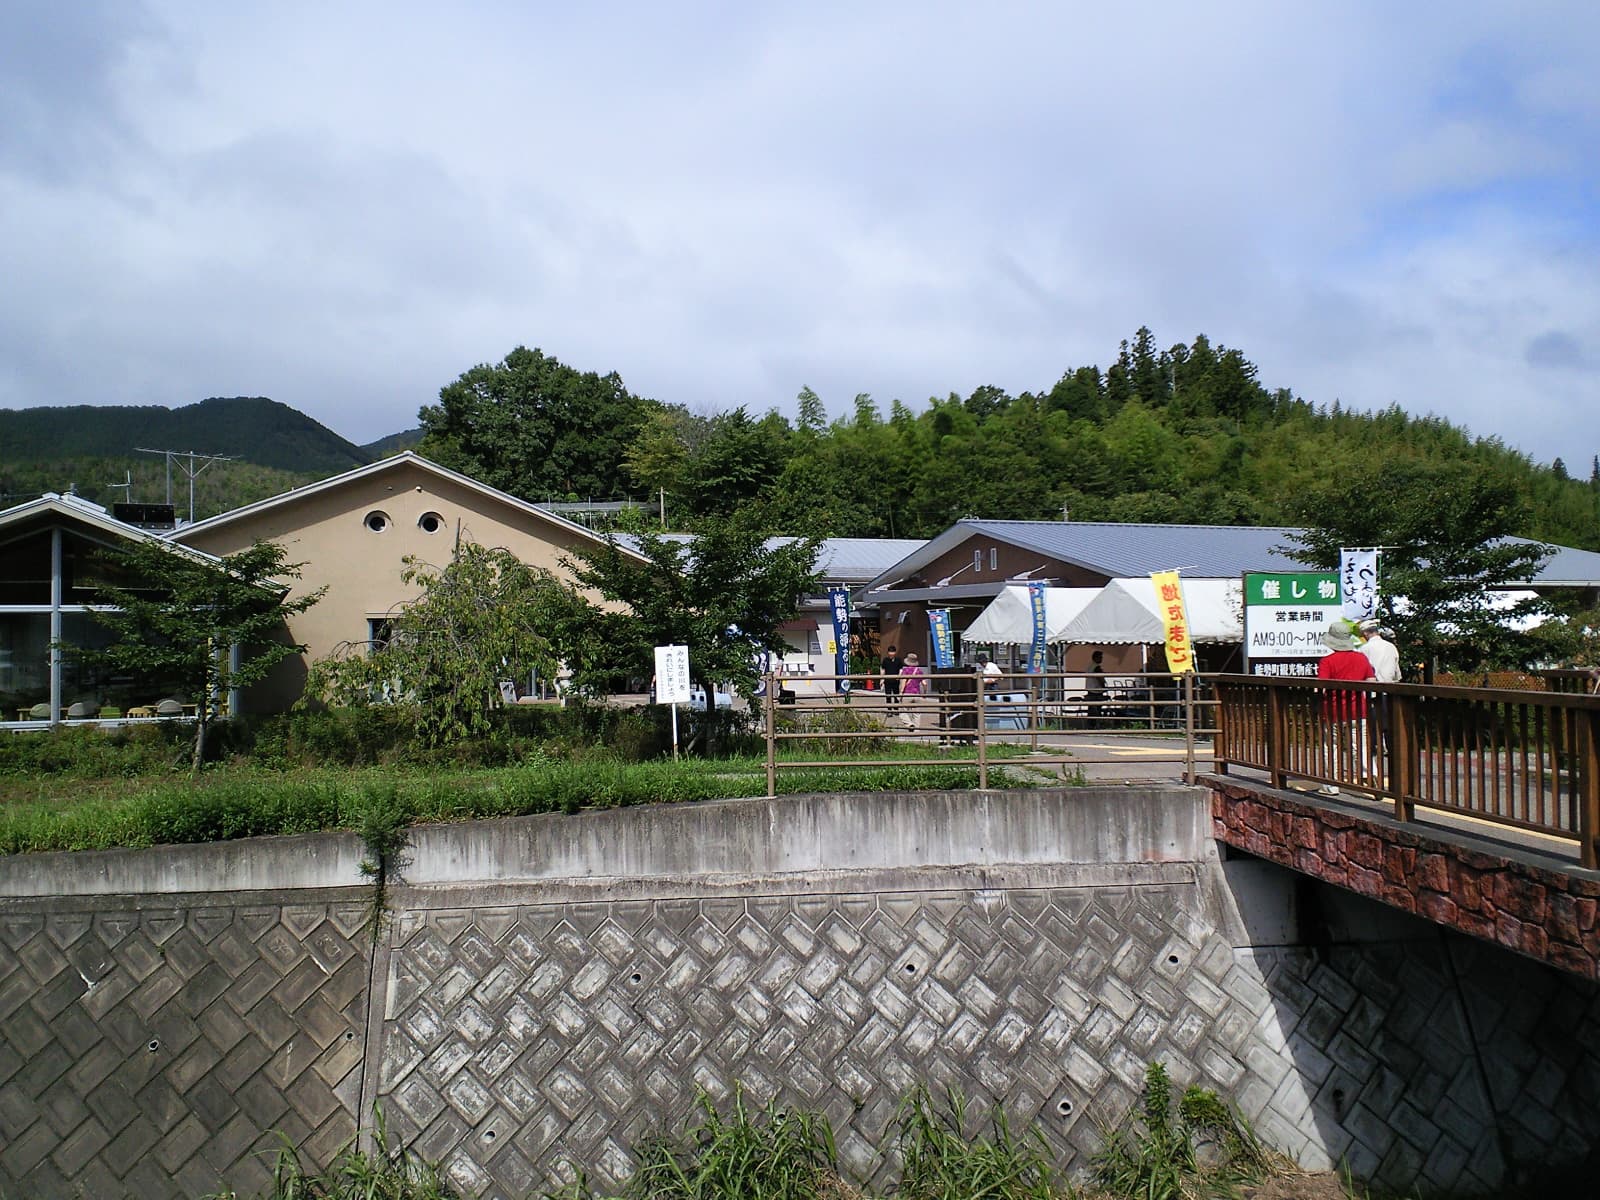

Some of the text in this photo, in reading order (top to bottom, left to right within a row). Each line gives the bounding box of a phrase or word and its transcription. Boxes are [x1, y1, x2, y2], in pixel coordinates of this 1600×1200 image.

[1261, 579, 1337, 599] 催し物
[1275, 610, 1323, 622] 営業時間
[1253, 631, 1327, 646] AM9:00～PM
[666, 653, 675, 697] きれいにしましょう
[677, 650, 686, 690] みんなの川を
